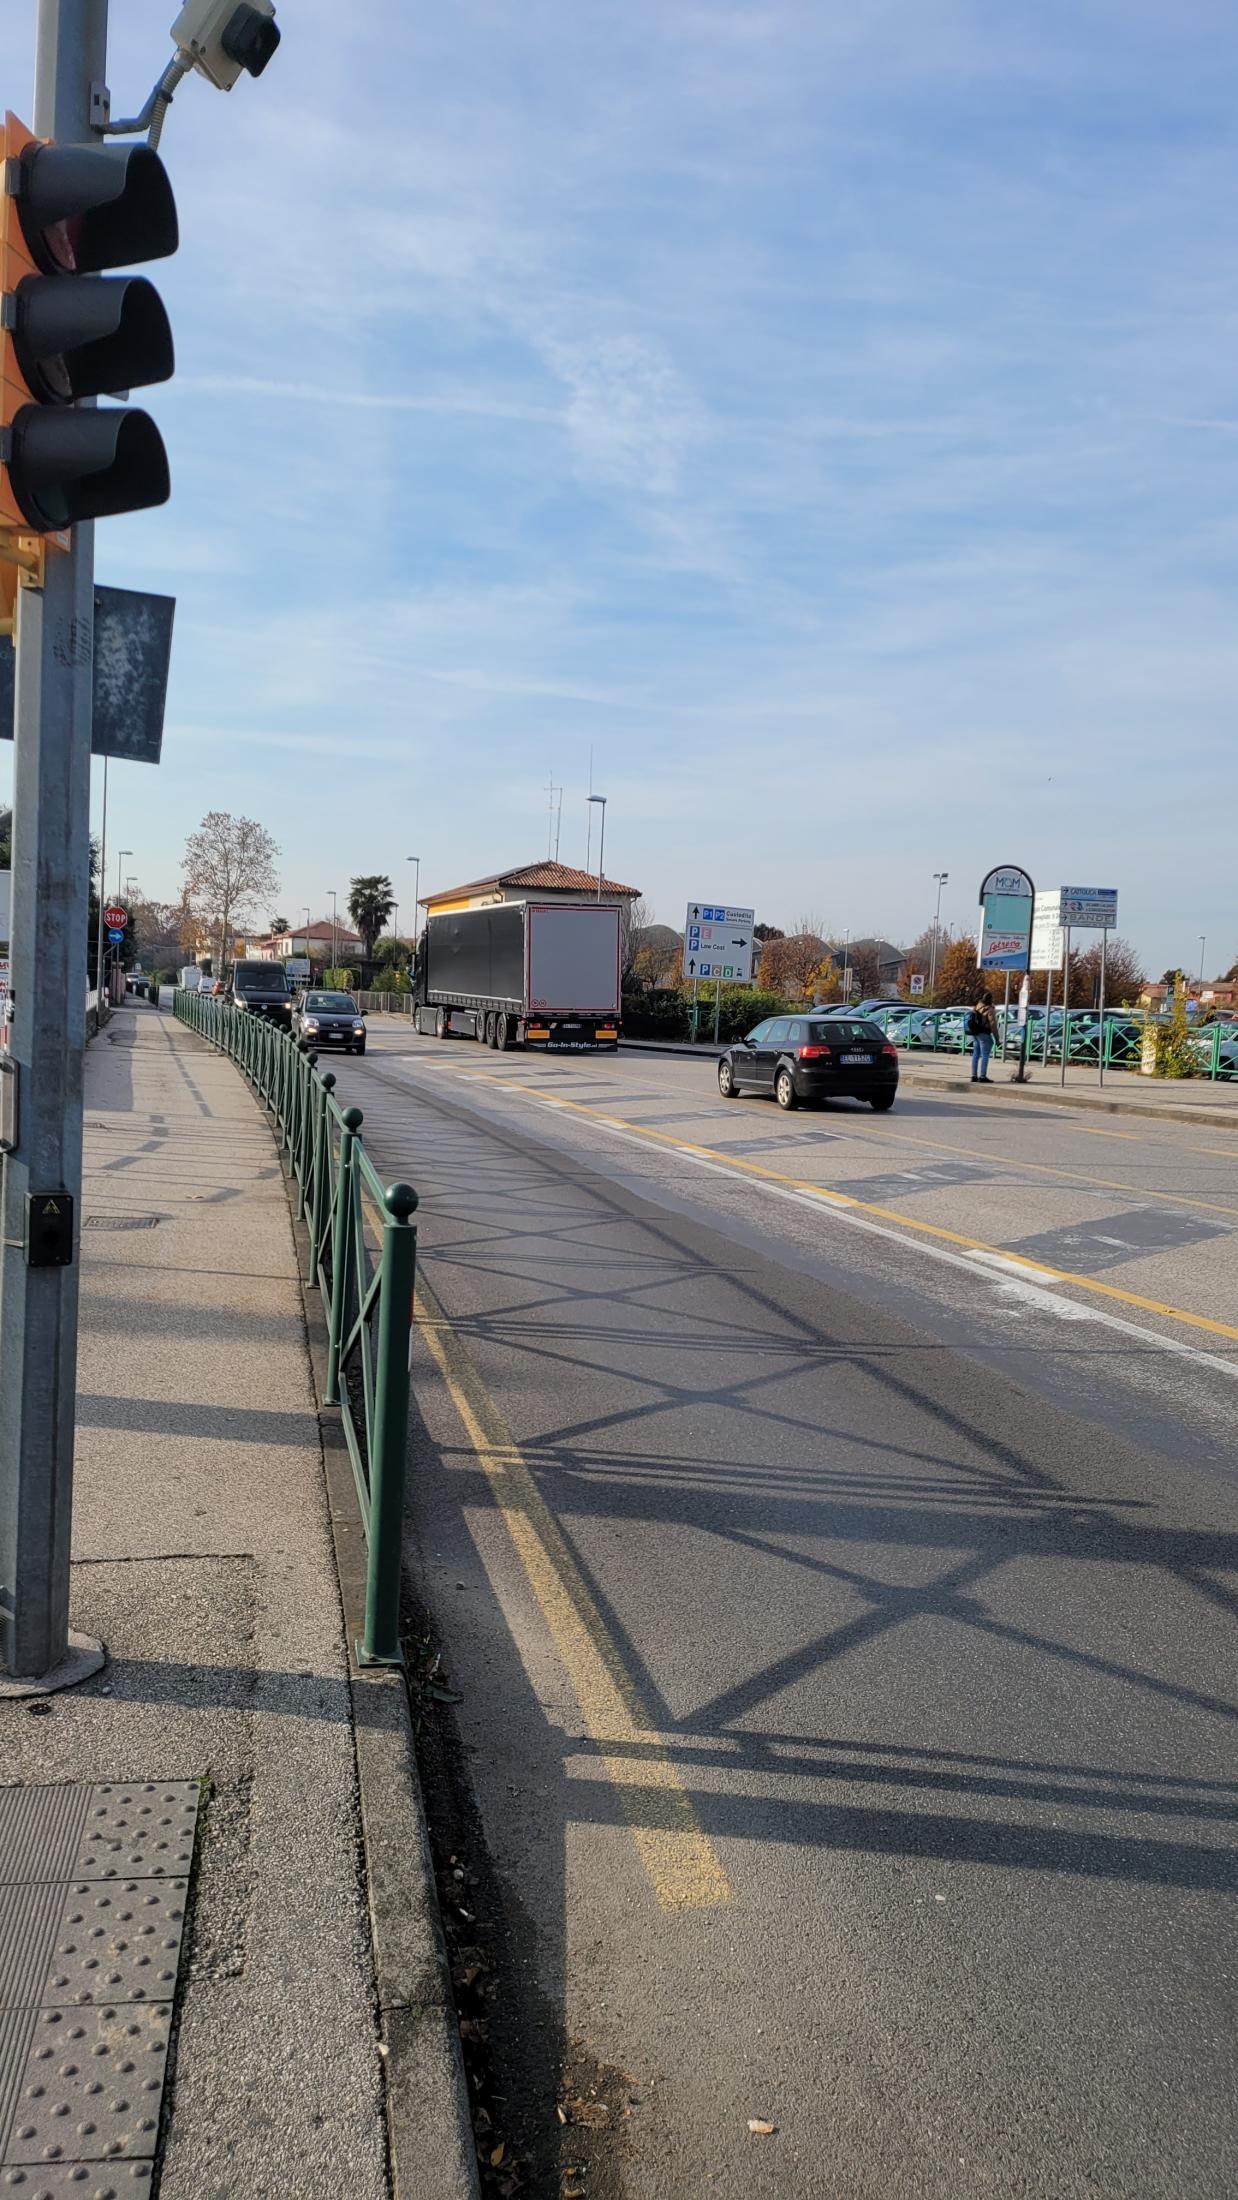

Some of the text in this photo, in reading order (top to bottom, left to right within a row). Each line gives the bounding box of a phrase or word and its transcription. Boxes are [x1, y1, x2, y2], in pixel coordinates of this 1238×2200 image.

[106, 912, 125, 923] STOP
[704, 910, 713, 918] P1
[715, 911, 725, 919] P2
[691, 928, 698, 937] P
[690, 940, 698, 950] P
[701, 965, 732, 977] P C D
